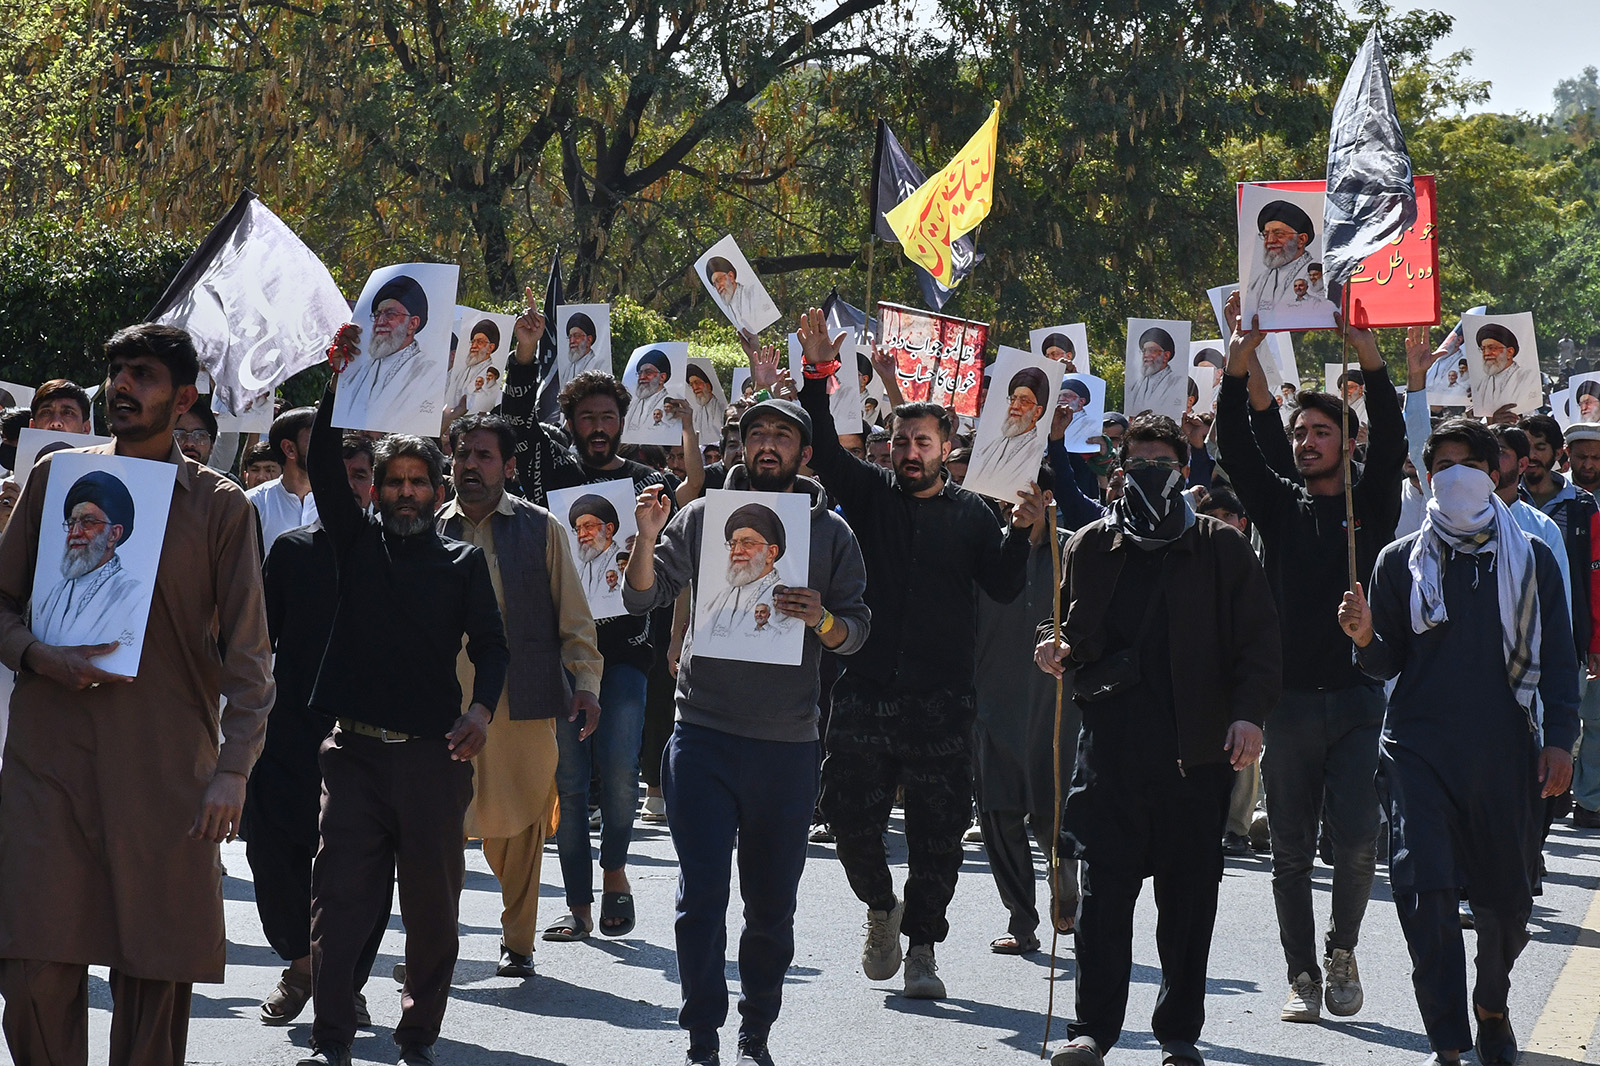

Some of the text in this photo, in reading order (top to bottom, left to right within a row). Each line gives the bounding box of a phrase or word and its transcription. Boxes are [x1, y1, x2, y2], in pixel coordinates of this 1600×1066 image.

[889, 336, 904, 348] دو
[905, 337, 943, 358] جواب
[897, 364, 975, 392] خون کا حساب
